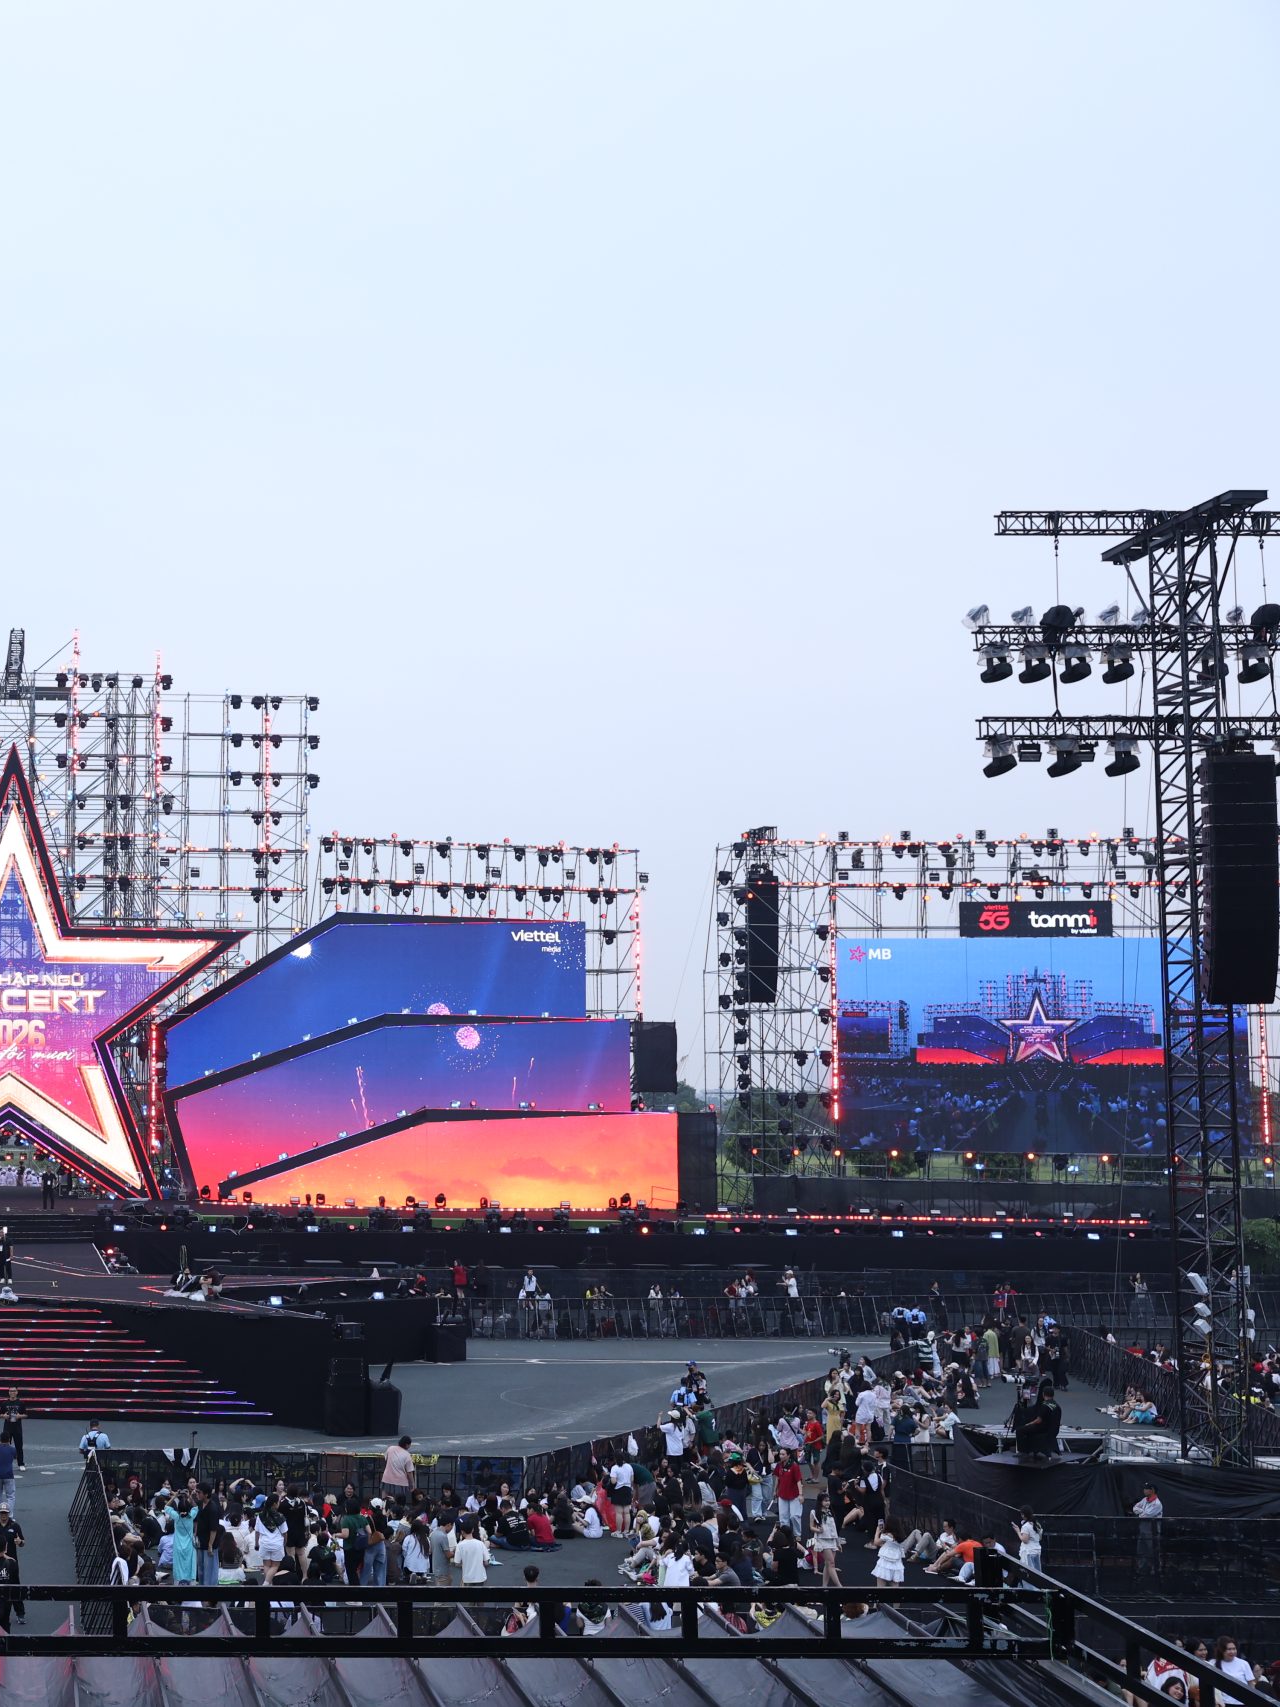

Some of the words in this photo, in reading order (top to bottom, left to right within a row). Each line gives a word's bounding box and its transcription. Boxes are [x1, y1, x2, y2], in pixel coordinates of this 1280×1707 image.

[978, 911, 1011, 931] 5G
[511, 929, 561, 942] viettel
[868, 948, 892, 960] MB
